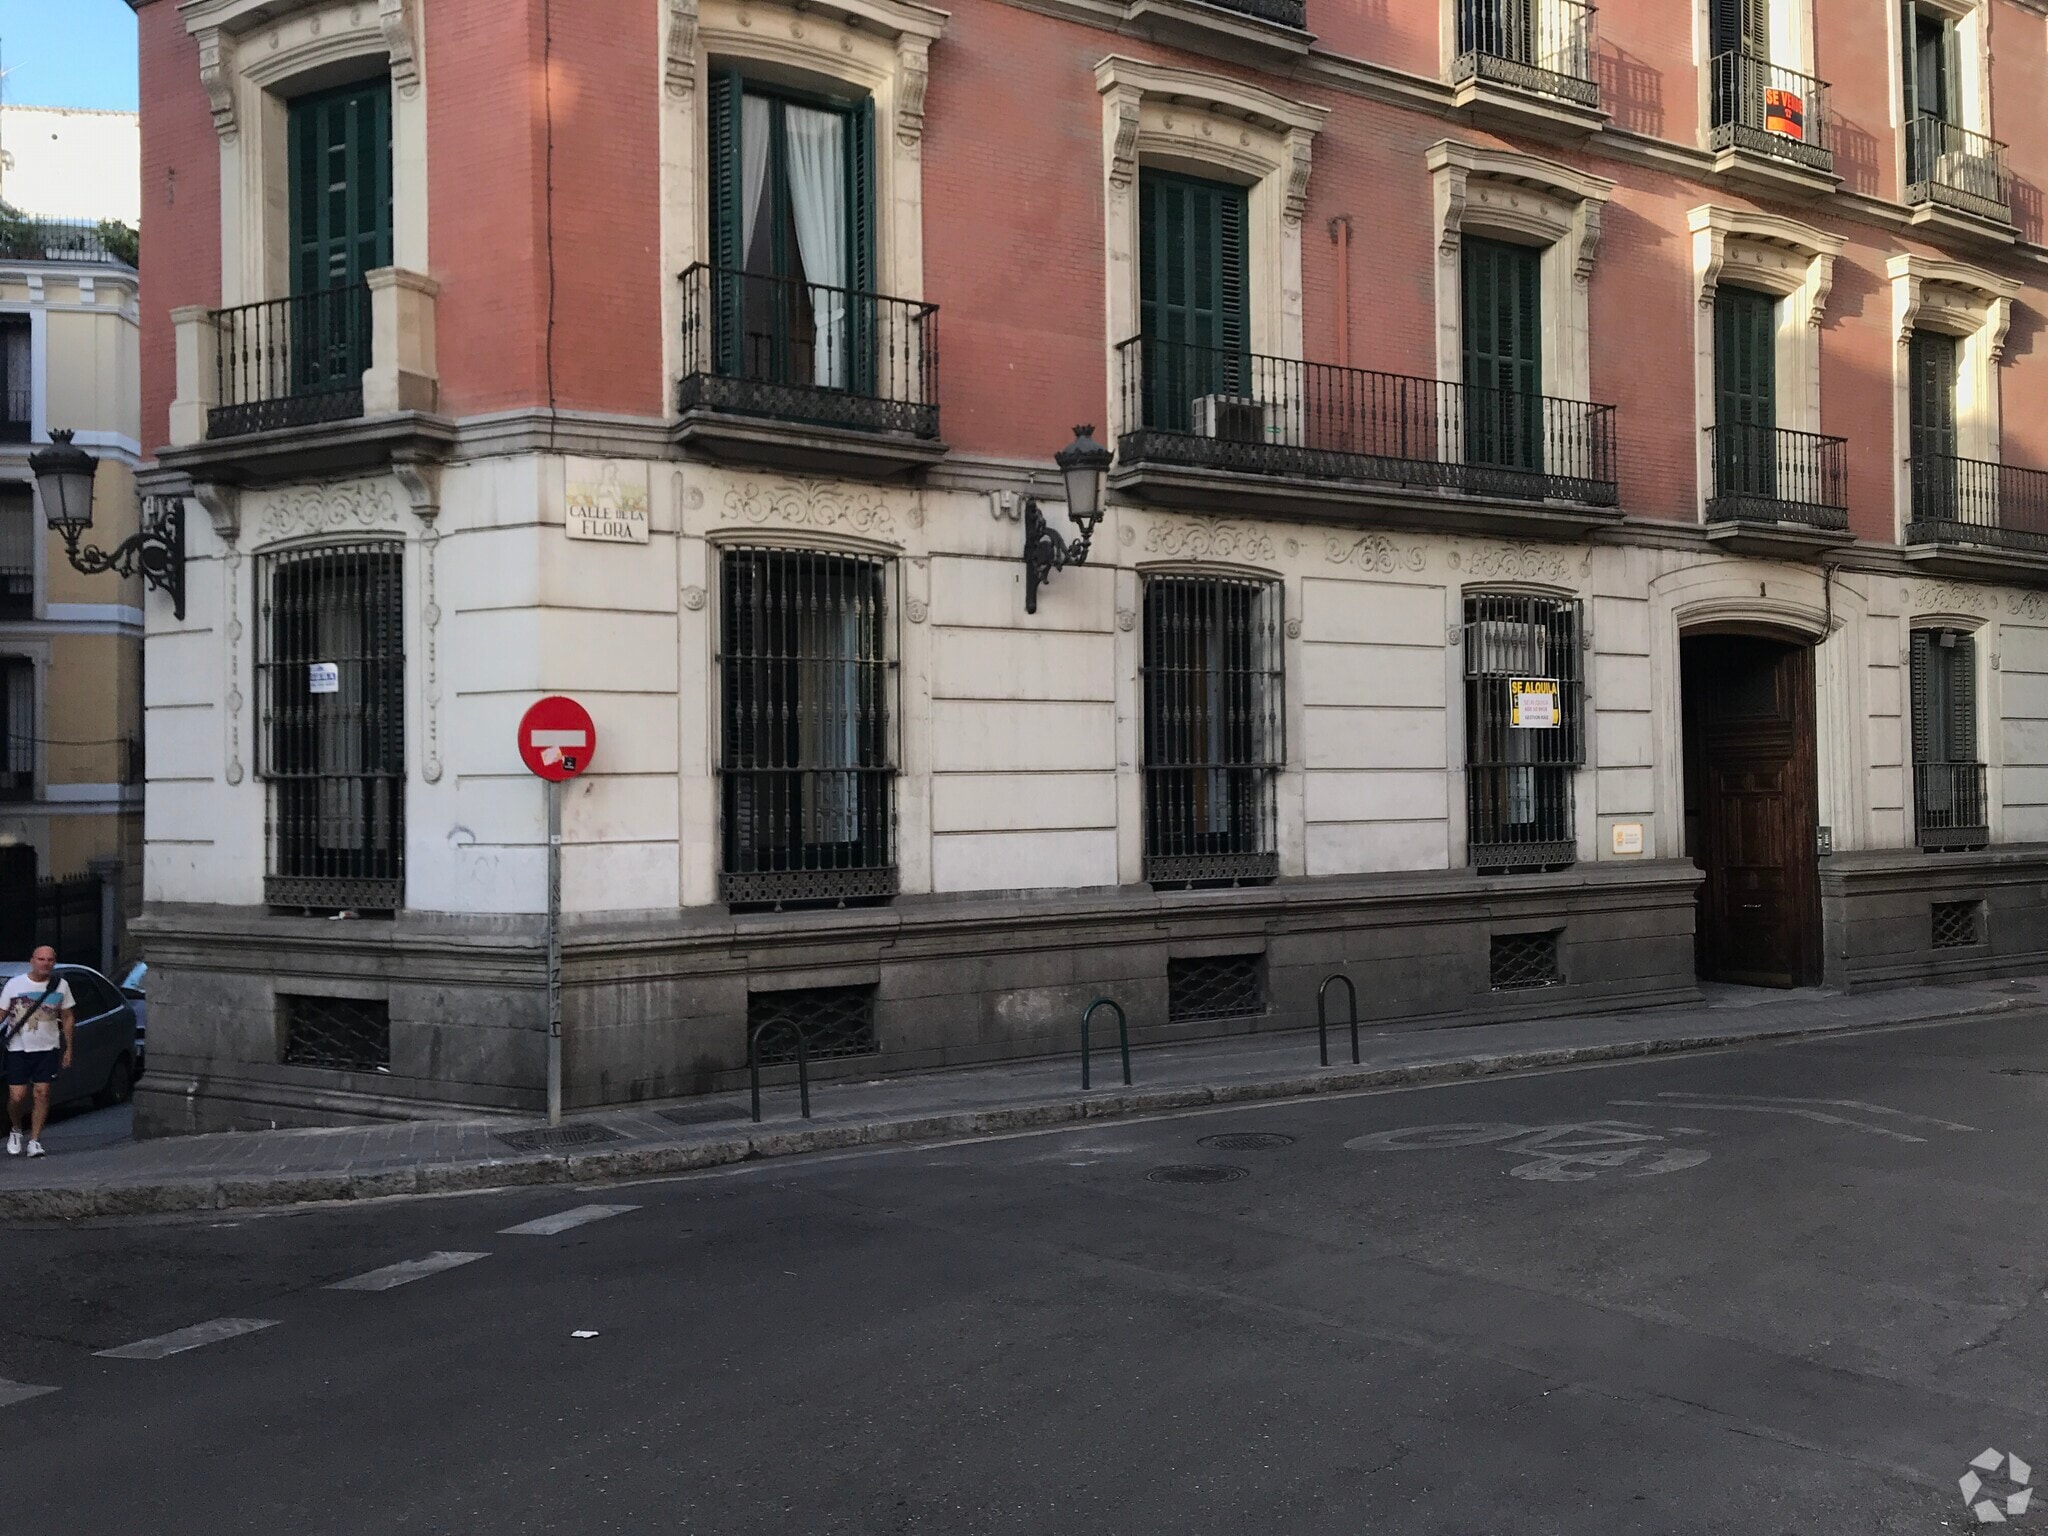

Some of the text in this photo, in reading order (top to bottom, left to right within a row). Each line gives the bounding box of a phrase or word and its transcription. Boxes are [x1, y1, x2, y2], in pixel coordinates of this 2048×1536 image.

[1766, 88, 1779, 105] SE
[570, 505, 644, 521] CALLE DE LA
[582, 519, 632, 538] FLORA
[1512, 681, 1558, 695] SE ALQUILA
